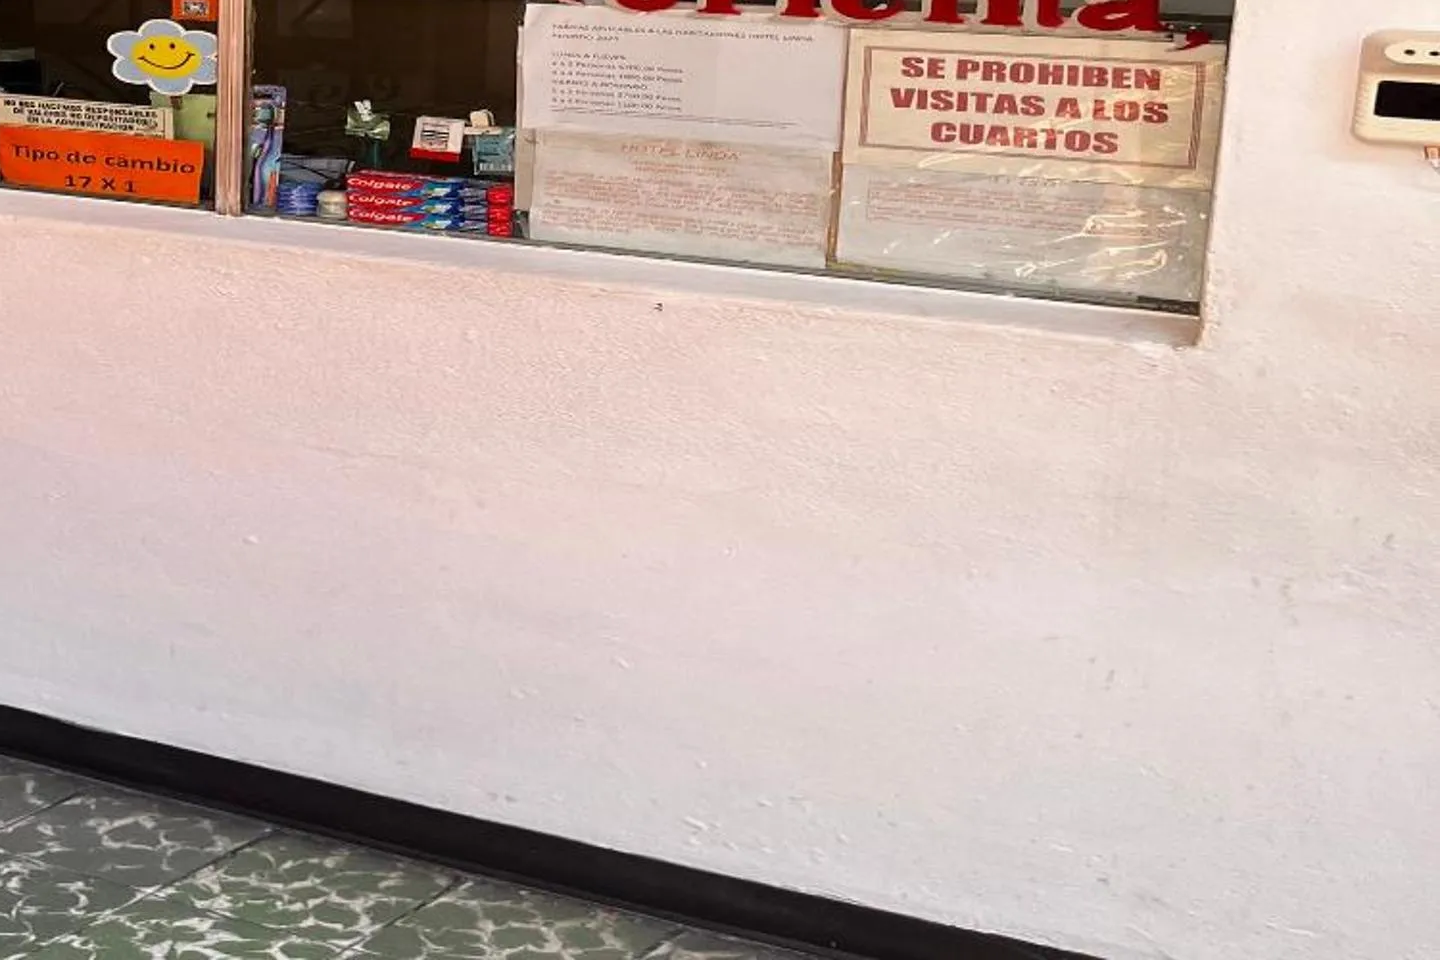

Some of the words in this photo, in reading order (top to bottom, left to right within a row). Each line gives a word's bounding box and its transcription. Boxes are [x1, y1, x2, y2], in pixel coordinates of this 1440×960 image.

[900, 55, 947, 80] SE
[955, 58, 1161, 91] PROHIBEN
[889, 87, 1046, 117] VISITAS
[1055, 96, 1082, 120] A
[1091, 98, 1170, 124] LOS
[929, 120, 1120, 154] CUARTOS
[13, 143, 60, 162] Tipo
[66, 149, 97, 165] de
[104, 153, 196, 174] cambio
[65, 174, 92, 189] 17
[126, 180, 139, 193] 1
[347, 176, 413, 190] Colgate
[348, 191, 414, 206] Colgate
[348, 208, 415, 223] Colgate
